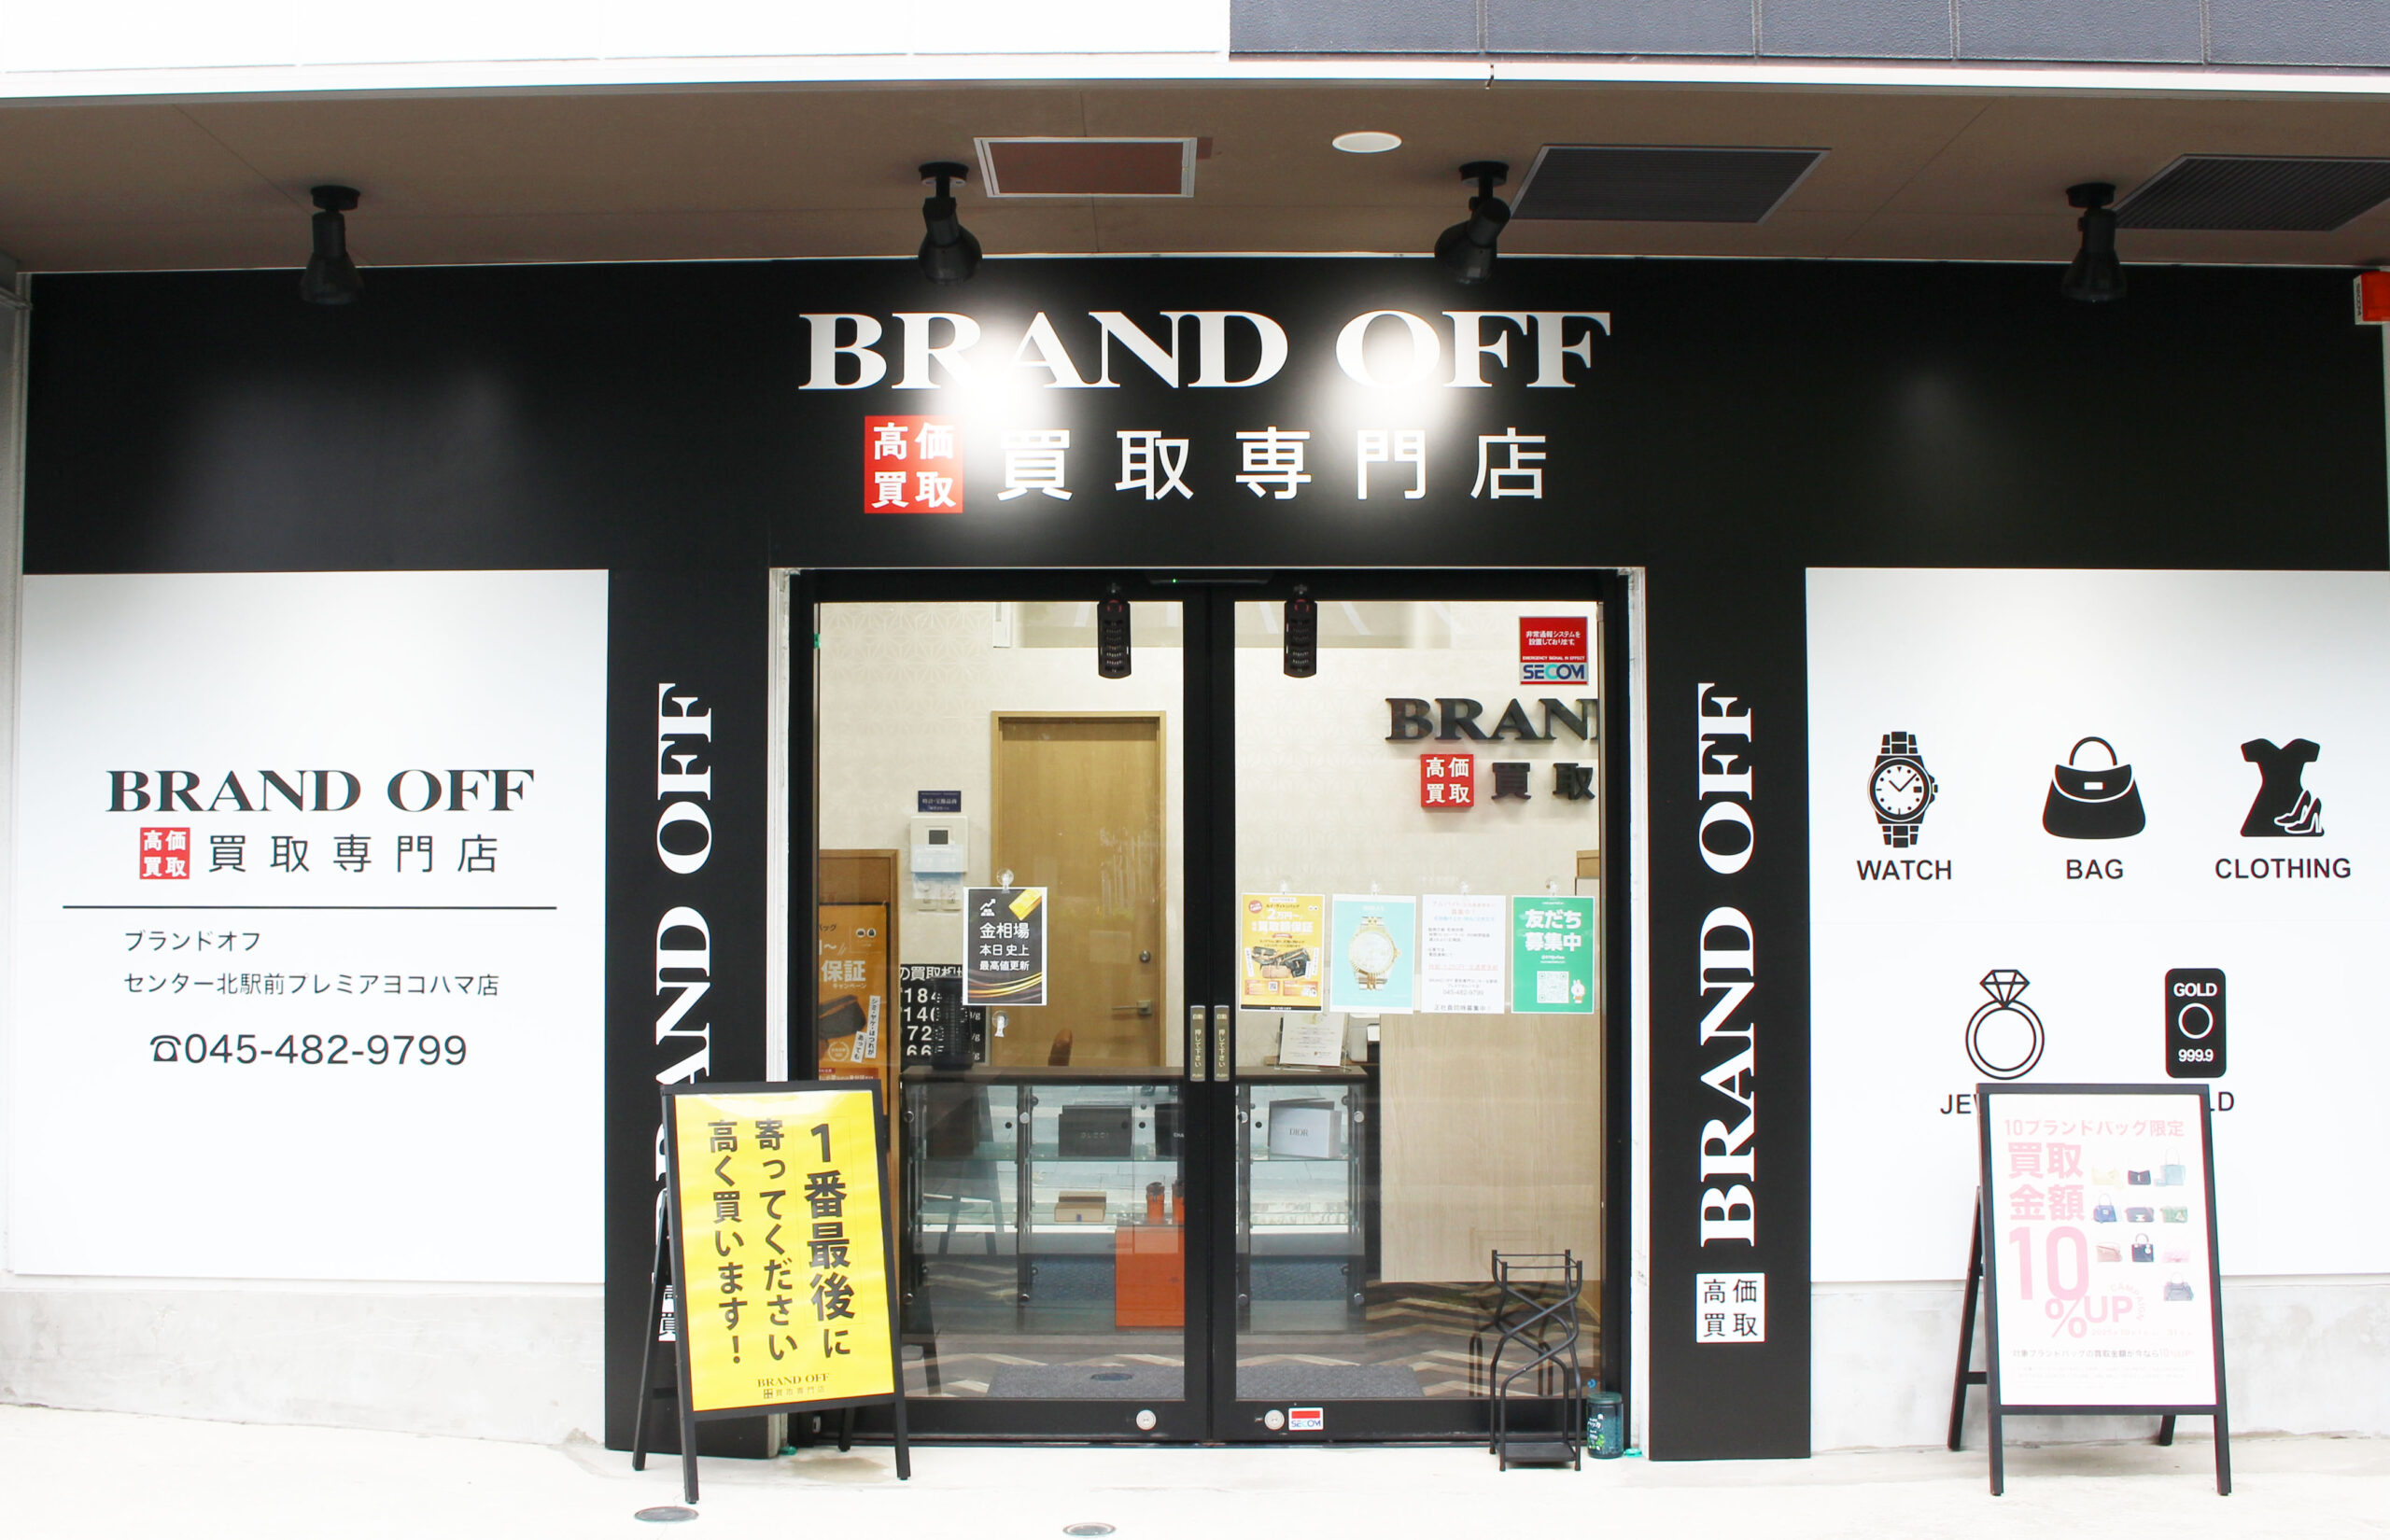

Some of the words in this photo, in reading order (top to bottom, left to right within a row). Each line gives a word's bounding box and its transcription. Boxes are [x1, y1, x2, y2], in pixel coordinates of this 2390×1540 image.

[797, 310, 1290, 390] BRAND
[1335, 309, 1612, 390] OFF
[872, 422, 956, 461] 高価
[996, 426, 1548, 502] 買取専門店
[872, 470, 958, 509] 買取
[1523, 664, 1585, 680] SECOM
[1385, 697, 1600, 741] BRAN
[655, 682, 713, 875] OFF
[1425, 757, 1470, 777] 高価
[1697, 682, 1753, 875] OFF
[105, 769, 361, 813] BRAND
[387, 769, 535, 813] OFF
[1425, 782, 1471, 804] 買取
[142, 829, 188, 852] 高価
[207, 833, 499, 874] 買取専門店
[141, 856, 188, 879] 買取
[1857, 860, 1953, 881] WATCH
[2066, 859, 2125, 880] BAG
[2214, 857, 2353, 880] CLOTHING
[979, 921, 1031, 940] 金相場
[1524, 908, 1582, 930] 友だち
[124, 930, 261, 953] ブランドオフ
[1525, 931, 1582, 952] 募集中
[822, 959, 867, 983] 保証
[979, 959, 1031, 973] 最高値更新
[123, 972, 500, 997] センター北駅前プレミアヨコハマ店
[2173, 982, 2218, 999] GOLD
[184, 1032, 468, 1066] 045-482-9799
[2177, 1048, 2214, 1063] 999.9
[1697, 905, 1755, 1248] BRAND
[2004, 1119, 2186, 1138] 10ブランドバッグ限定
[2007, 1141, 2085, 1179] 買取
[2008, 1183, 2086, 1222] 金額
[707, 1119, 748, 1365] 高く買います！
[754, 1118, 798, 1362] 寄ってください
[803, 1123, 855, 1359] 1番最後に
[2008, 1225, 2090, 1301] 10
[1704, 1279, 1757, 1304] 高価
[1704, 1312, 1758, 1337] 買取
[757, 1375, 802, 1388] BRAND
[805, 1372, 830, 1383] OFF
[1290, 1419, 1321, 1427] SECOM
